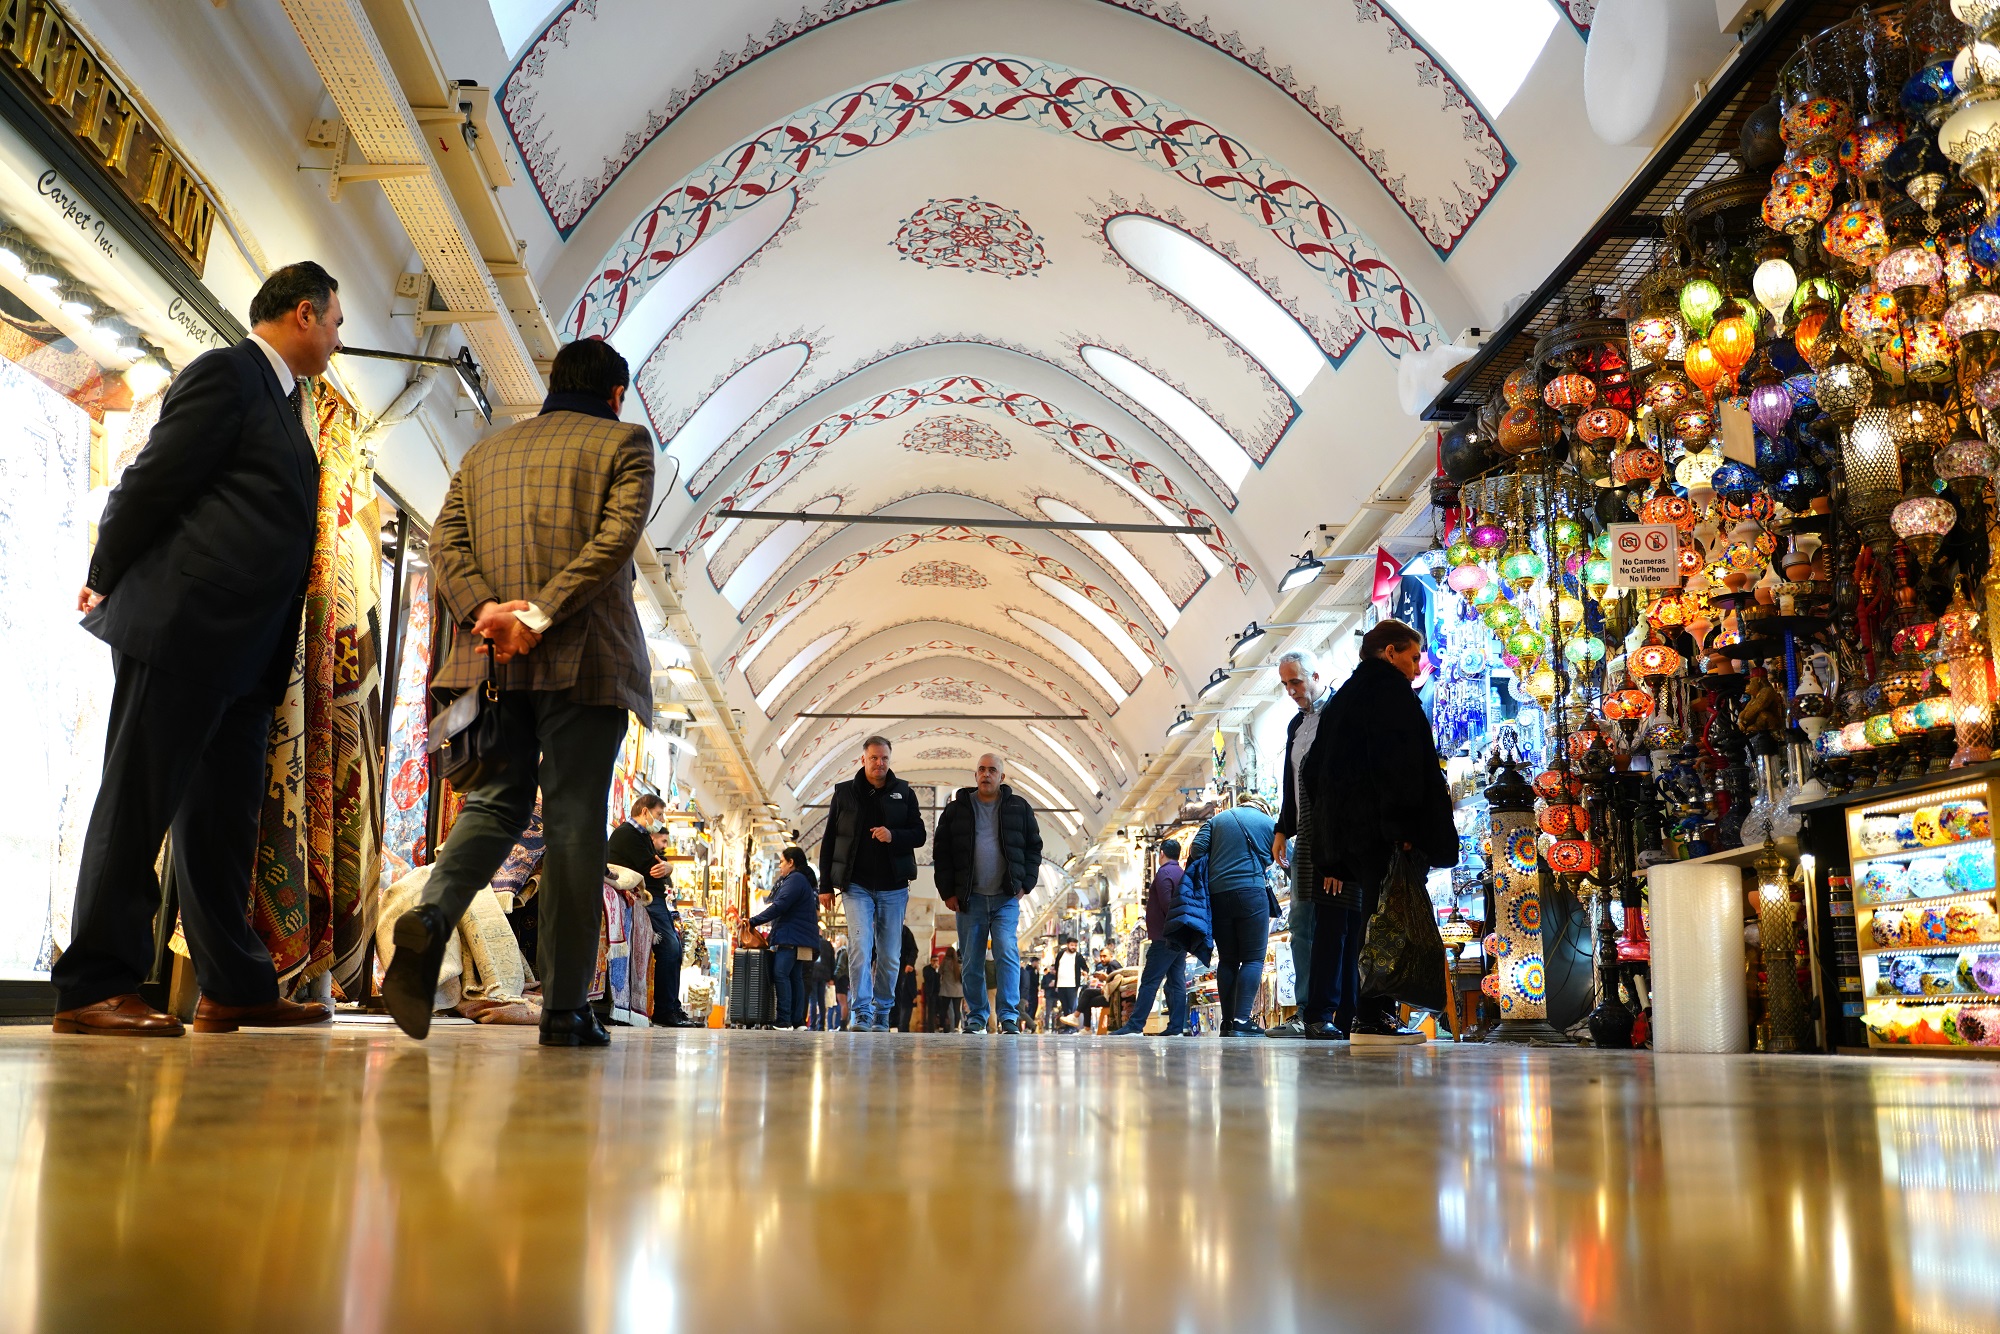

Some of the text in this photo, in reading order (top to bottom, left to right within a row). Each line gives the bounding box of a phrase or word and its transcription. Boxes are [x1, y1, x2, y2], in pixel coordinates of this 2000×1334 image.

[37, 169, 92, 231] Carpet
[142, 143, 216, 263] INN
[168, 296, 207, 344] Carpet
[1631, 566, 1645, 574] Cell
[1640, 574, 1661, 582] Video
